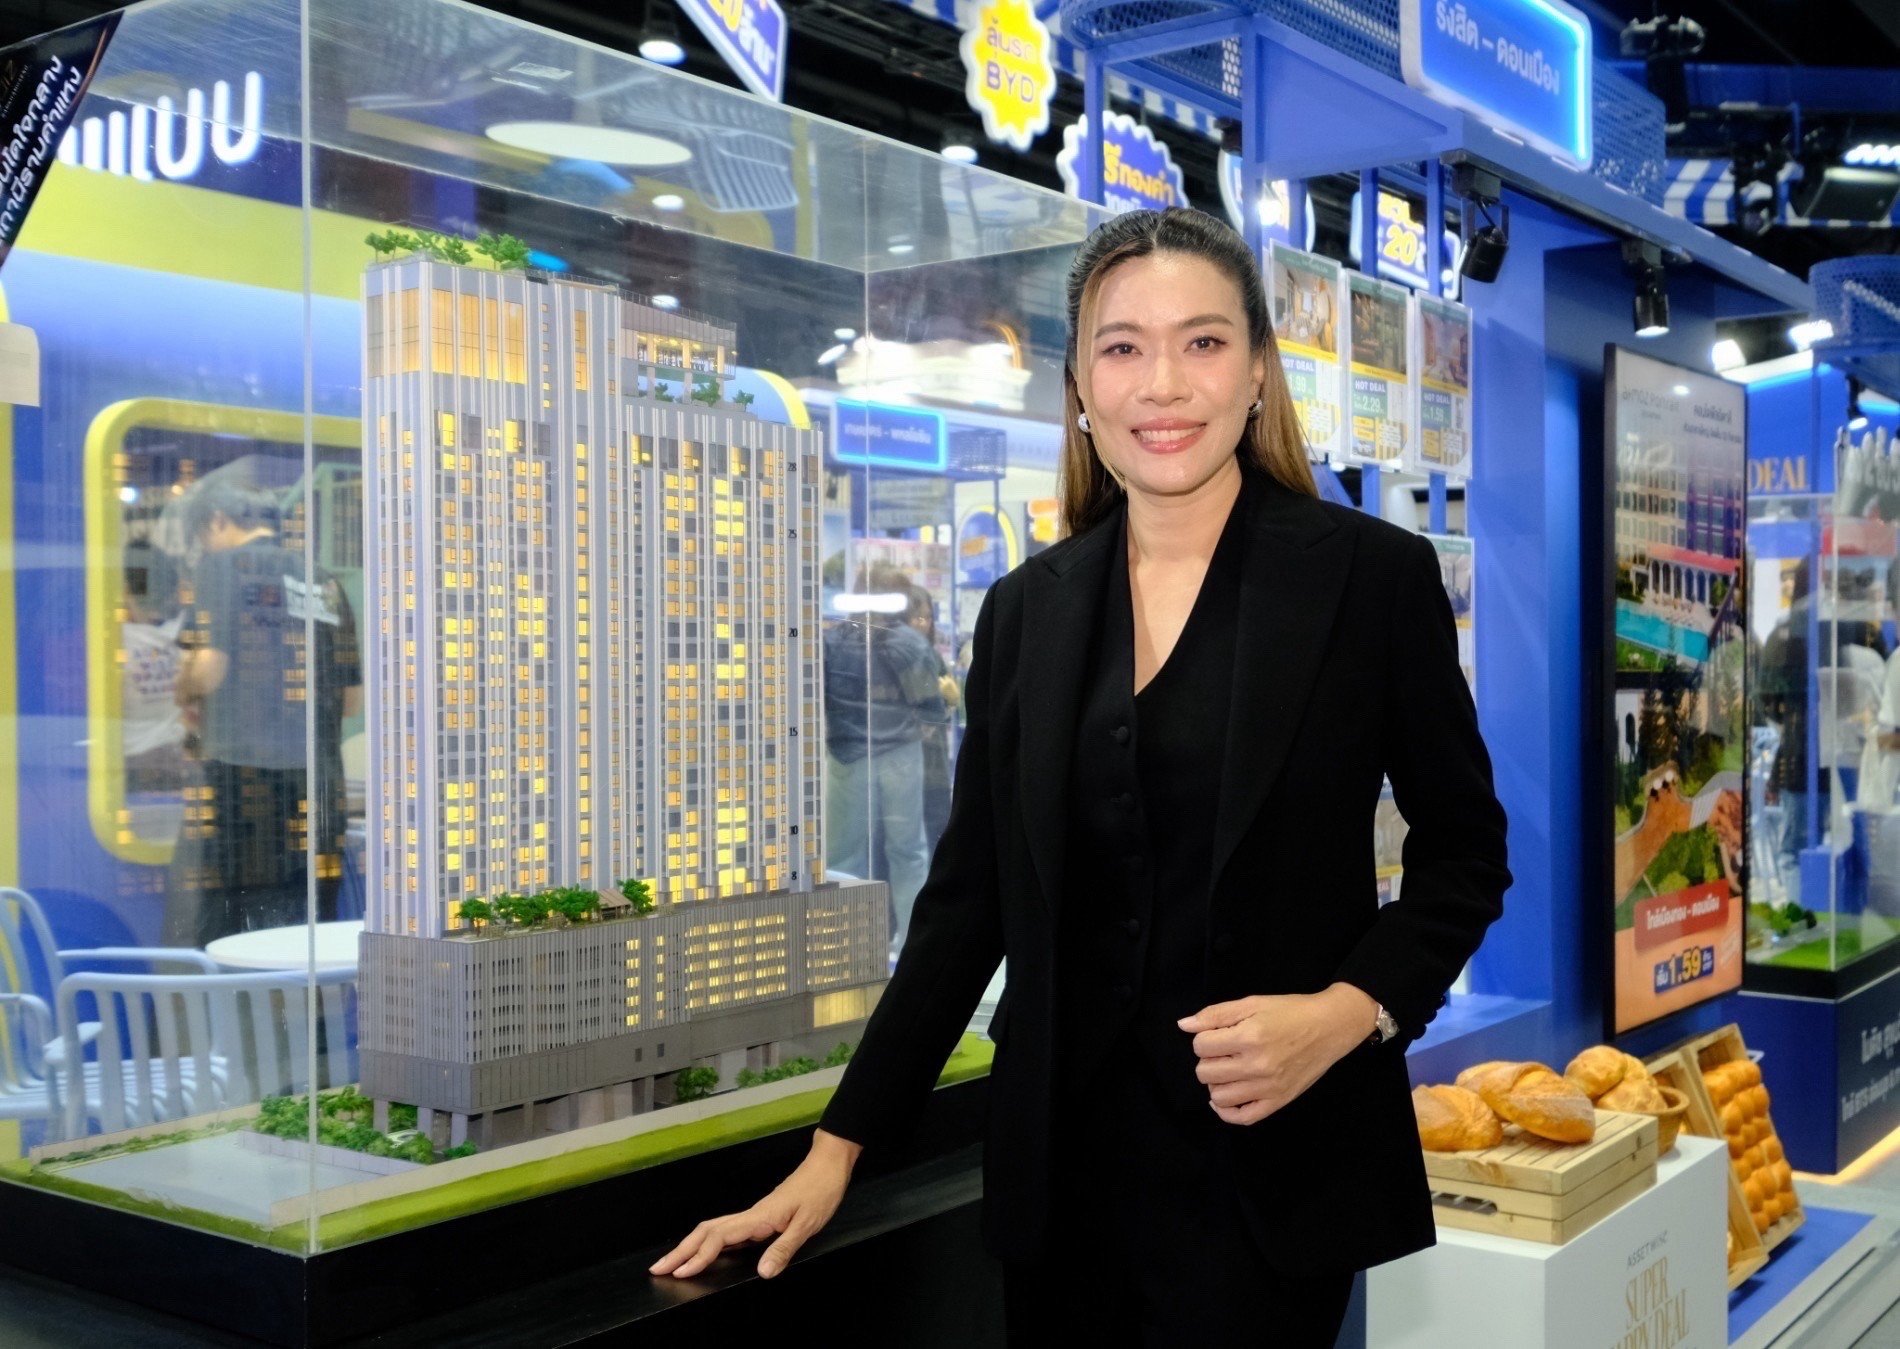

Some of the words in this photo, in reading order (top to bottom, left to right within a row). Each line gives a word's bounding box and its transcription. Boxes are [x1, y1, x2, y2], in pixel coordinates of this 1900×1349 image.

[1435, 0, 1479, 50] รงสิต
[986, 60, 1035, 103] BYD
[1384, 224, 1419, 267] 20
[1355, 380, 1369, 391] HOT
[1369, 382, 1386, 393] DEAL
[787, 461, 797, 472] 28
[788, 627, 798, 638] 20
[788, 726, 798, 737] 15
[789, 825, 799, 835] 10
[791, 870, 798, 881] 8
[1669, 946, 1701, 986] 1.59
